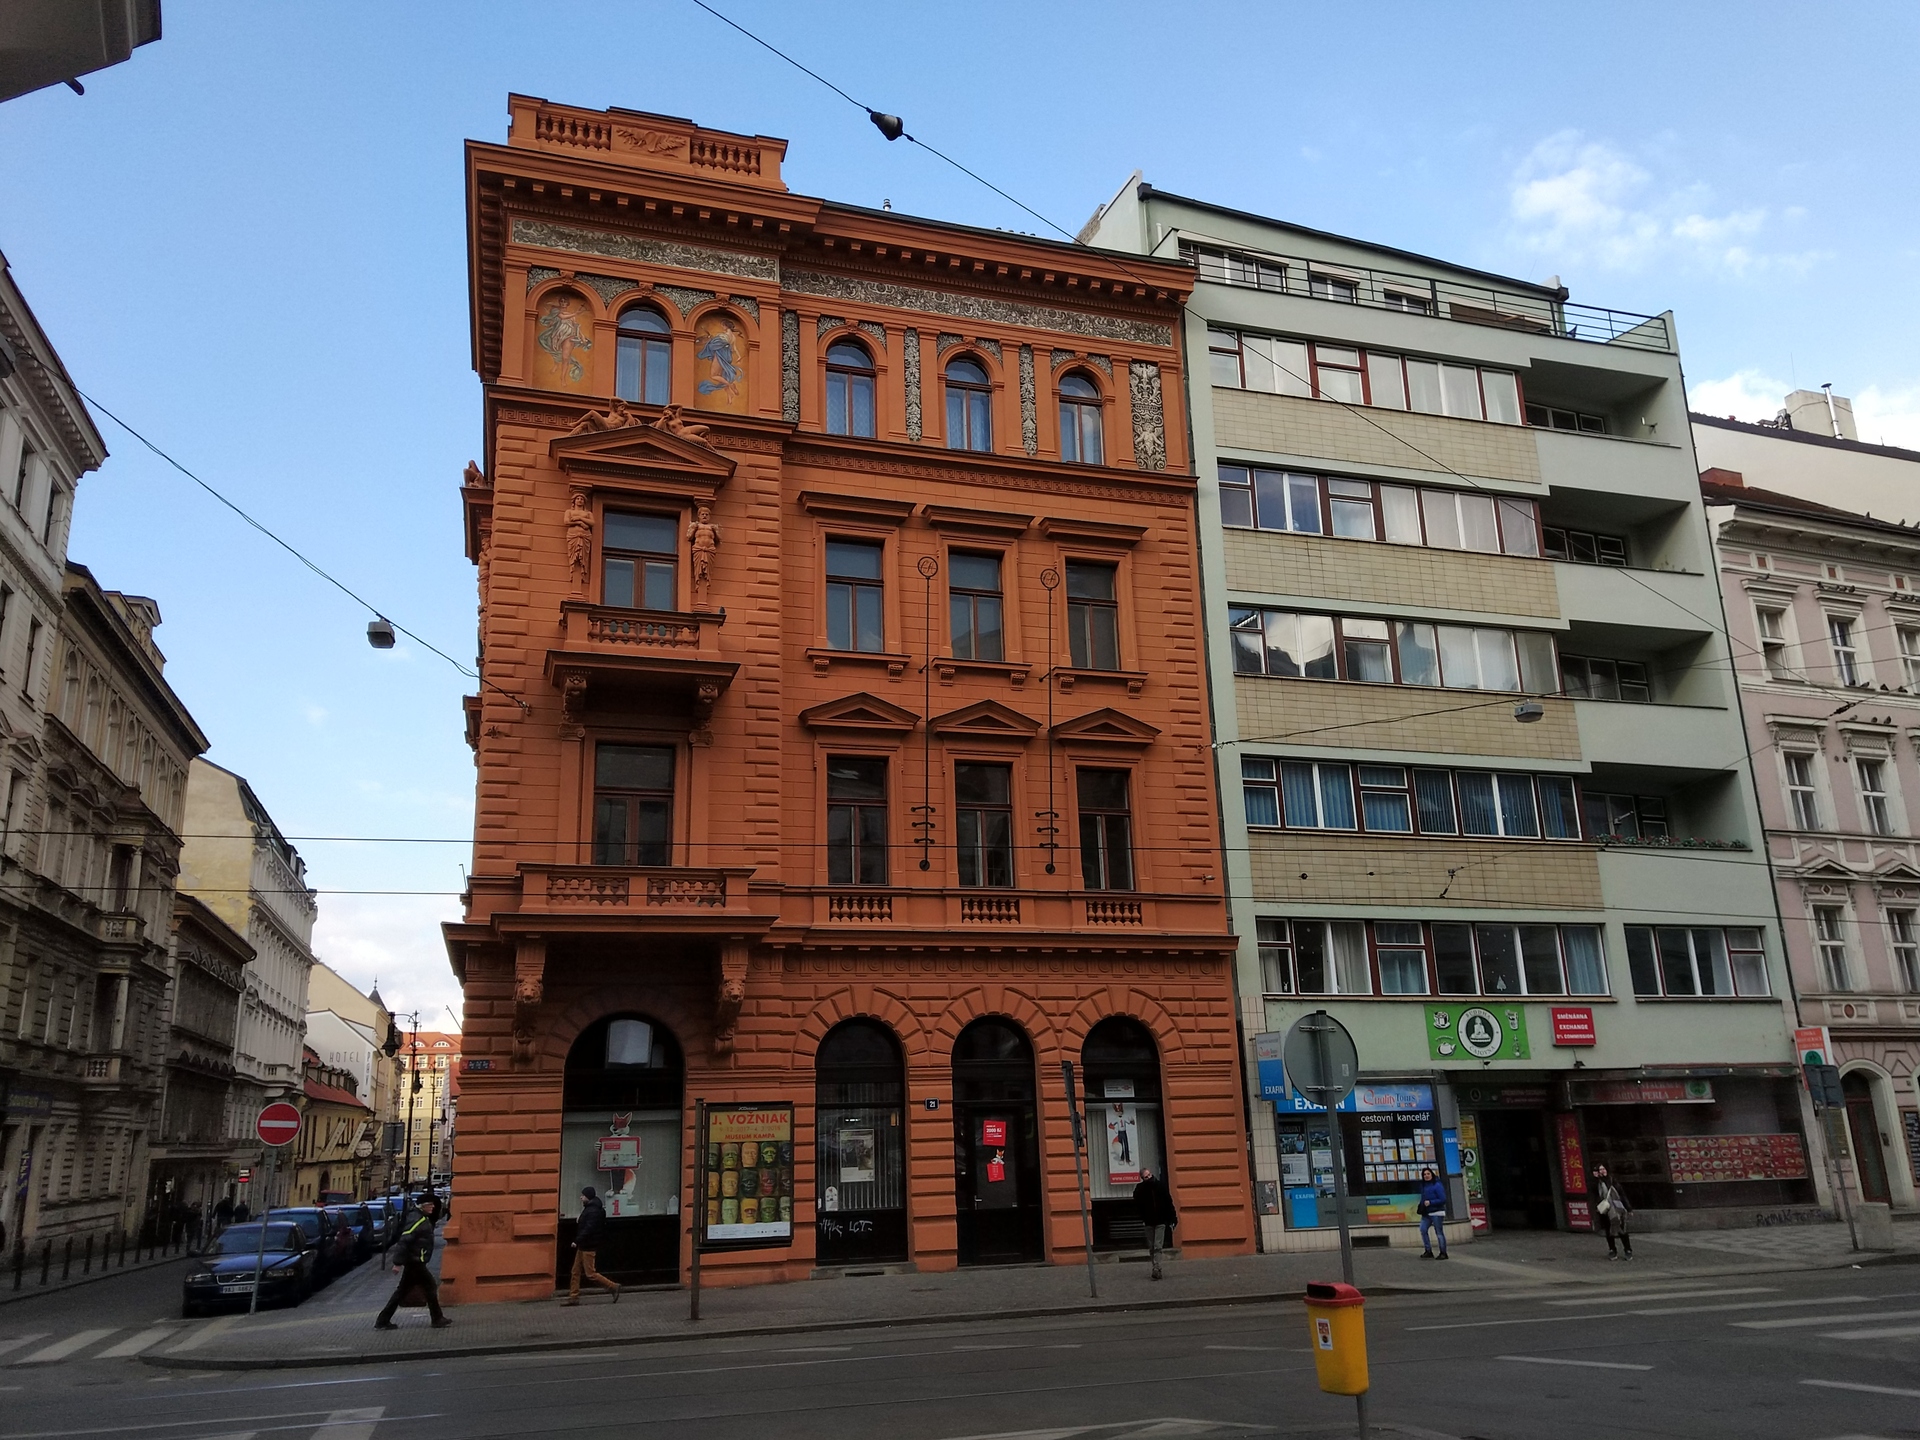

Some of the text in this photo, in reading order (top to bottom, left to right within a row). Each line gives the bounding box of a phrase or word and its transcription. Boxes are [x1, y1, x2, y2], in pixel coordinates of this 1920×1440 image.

[1465, 1009, 1491, 1020] BUDDHA
[1557, 1012, 1588, 1020] SMĚNÁRNA
[329, 1051, 360, 1063] HOTEL
[1264, 1085, 1284, 1095] EXAFIN
[1641, 1090, 1669, 1100] PERLA
[1363, 1088, 1416, 1108] Quality Tours
[929, 1100, 936, 1108] 21
[712, 1111, 788, 1125] J. VOŽNIAK
[1360, 1112, 1430, 1123] cestovní kancelář
